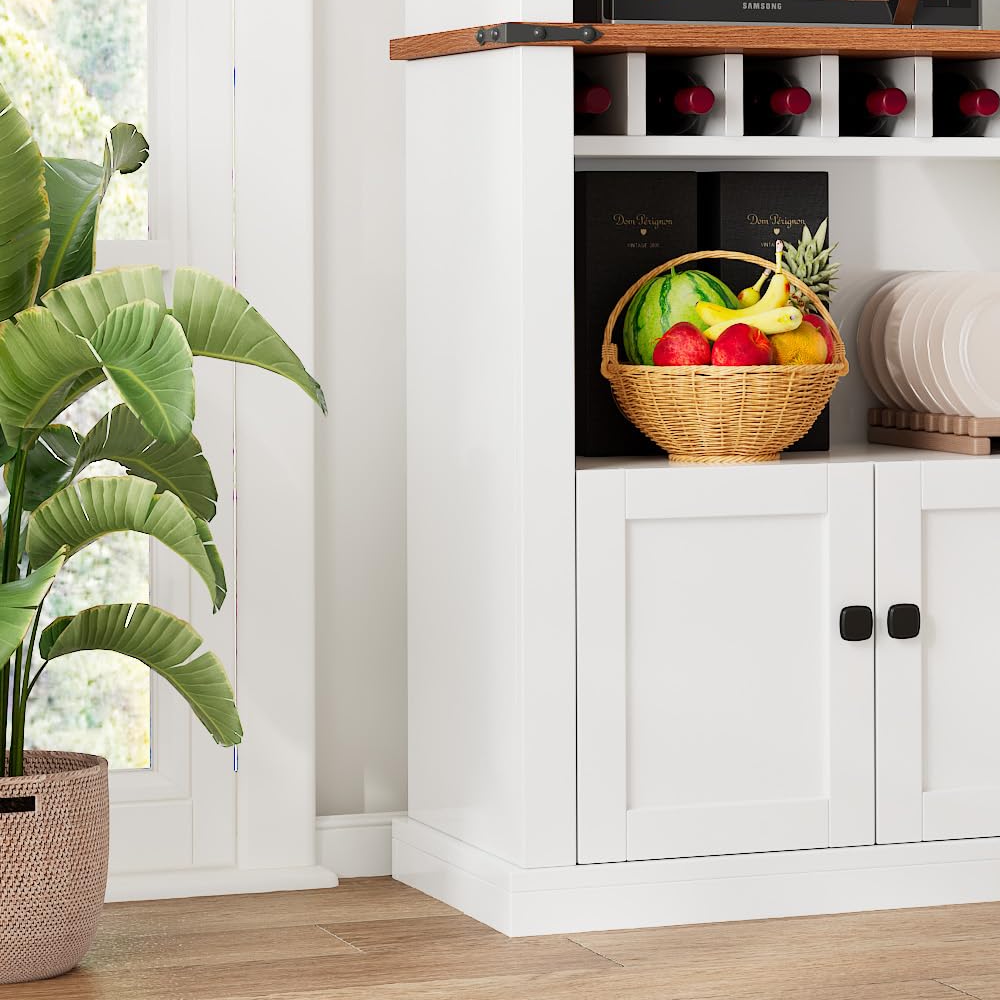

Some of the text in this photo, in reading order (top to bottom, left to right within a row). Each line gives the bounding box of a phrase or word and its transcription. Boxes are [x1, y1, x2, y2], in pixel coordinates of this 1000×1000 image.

[613, 213, 673, 229] Dom Pérignon
[747, 213, 805, 229] Dom Pérignon
